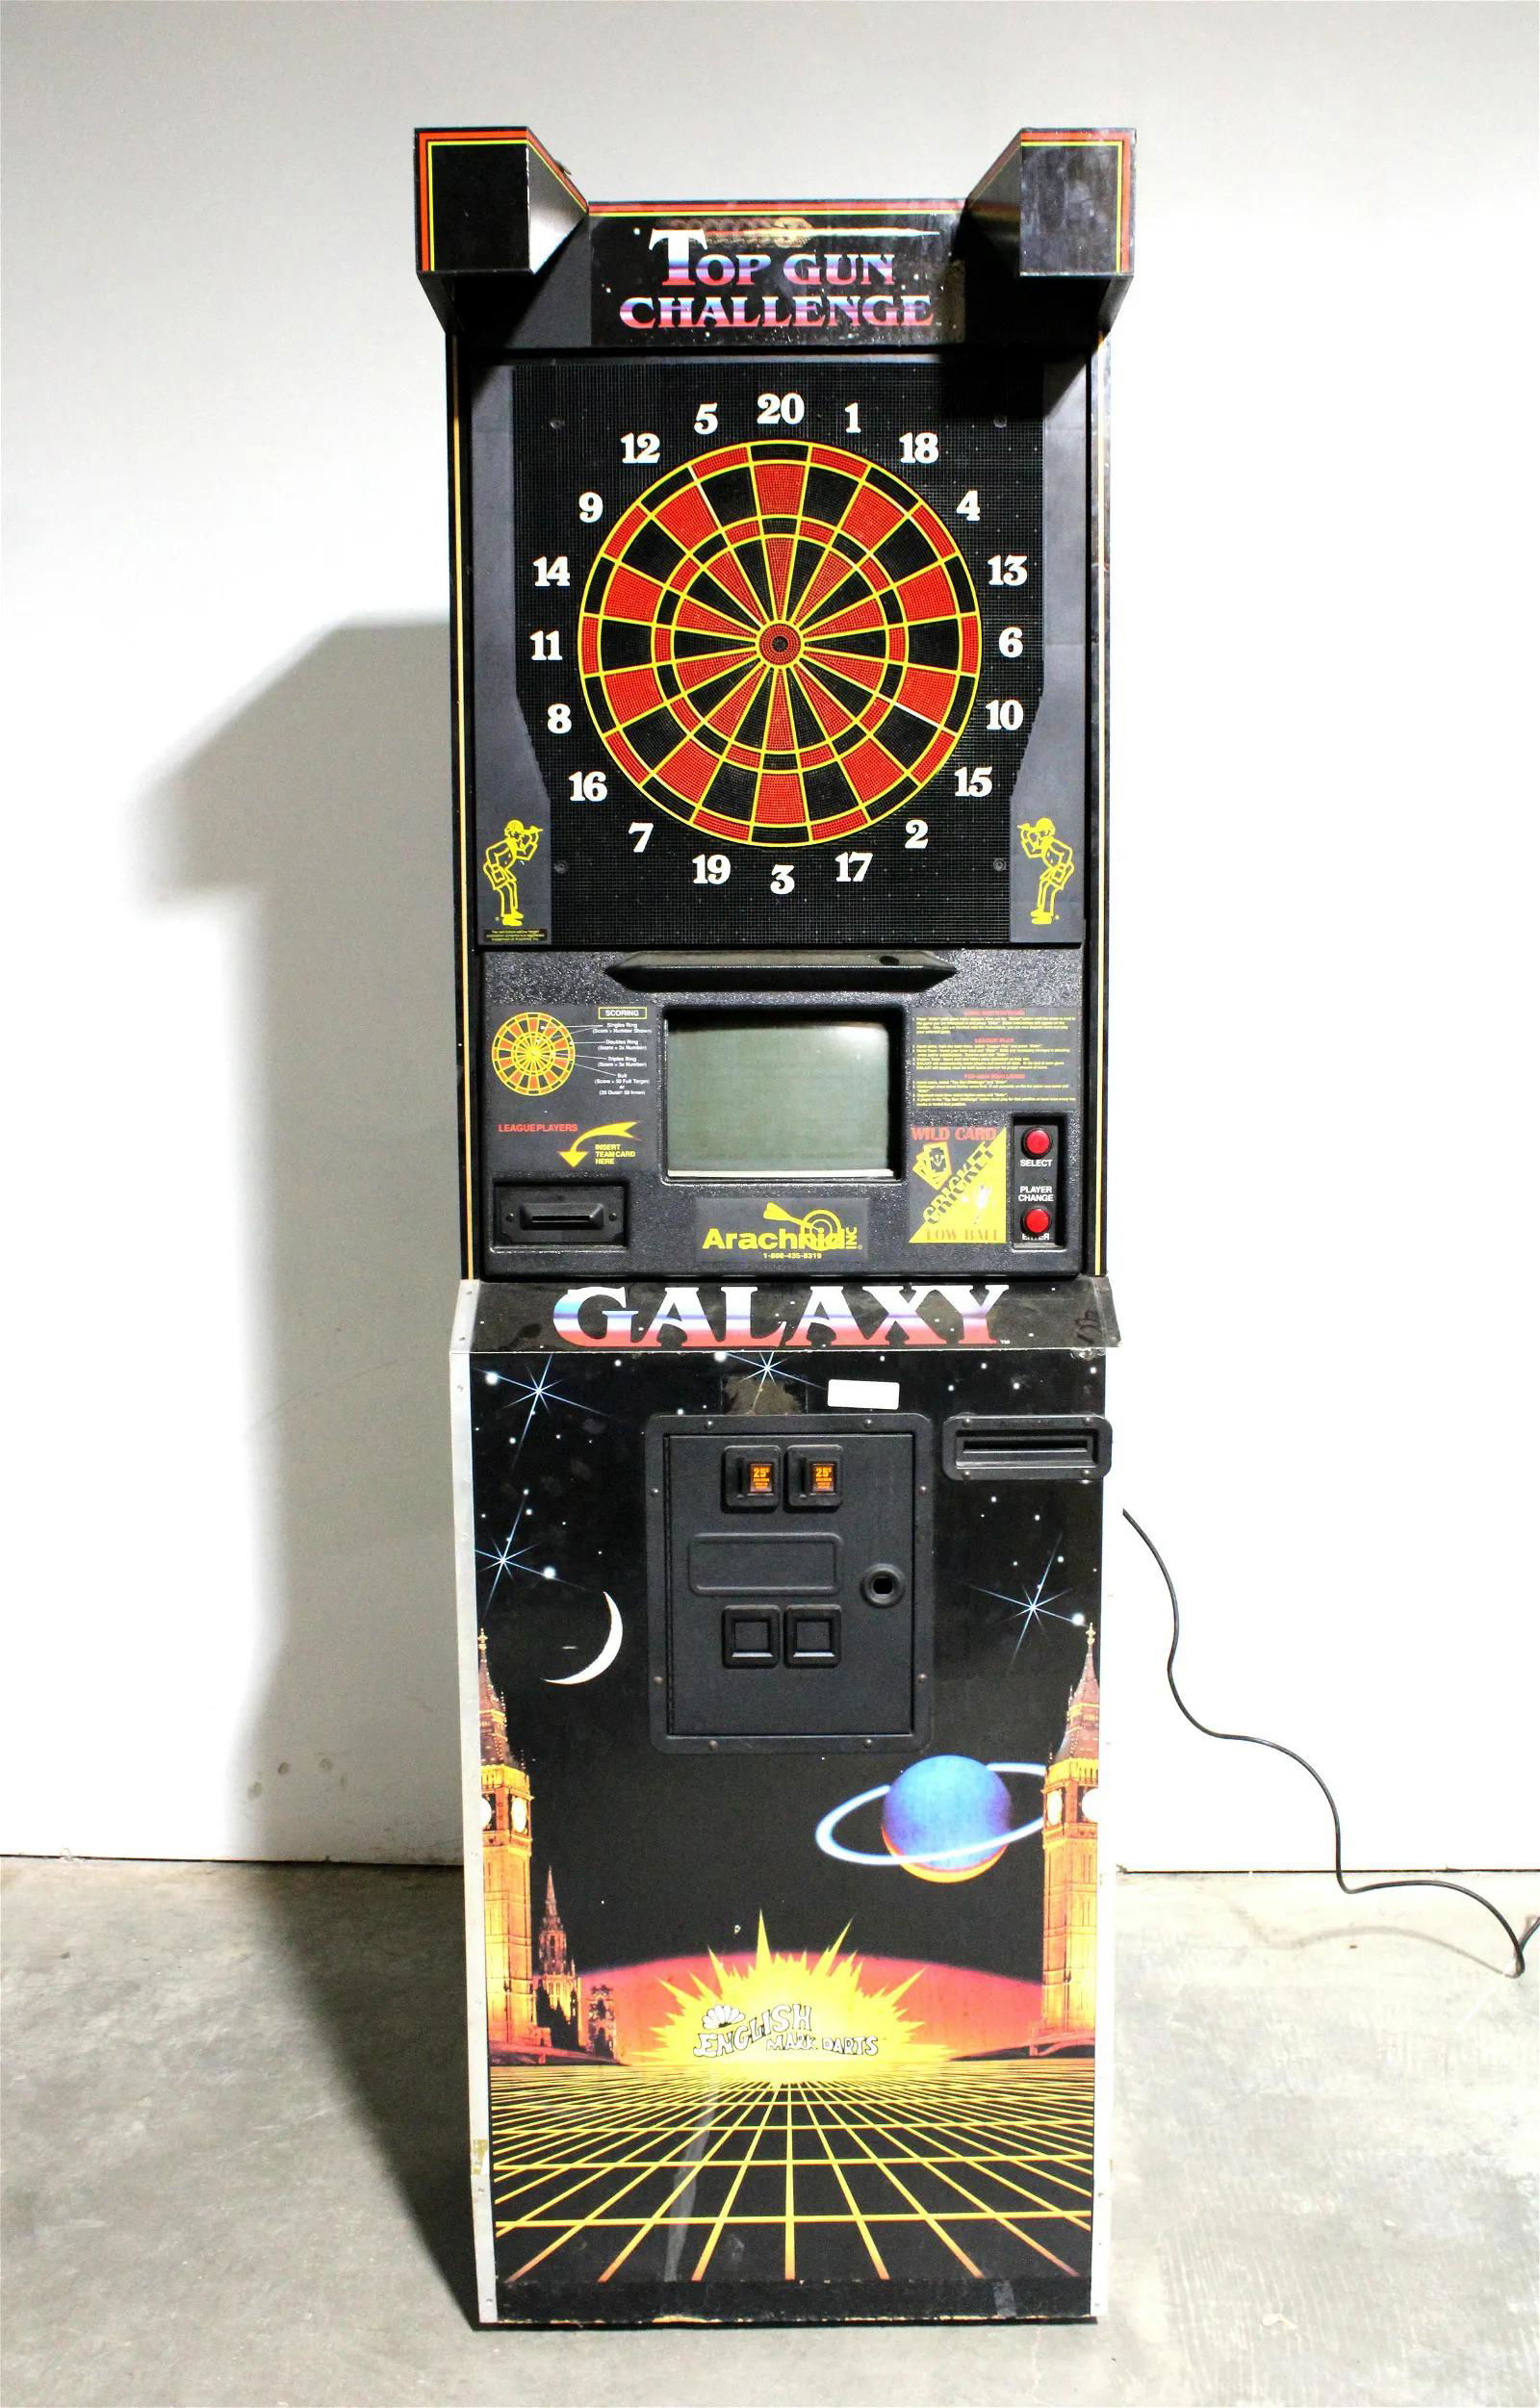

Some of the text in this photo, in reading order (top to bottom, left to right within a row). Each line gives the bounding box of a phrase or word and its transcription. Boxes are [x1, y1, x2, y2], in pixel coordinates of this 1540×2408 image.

[783, 253, 895, 286] GUN
[619, 295, 934, 329] CHALLENGE
[694, 403, 718, 434] 5
[757, 394, 805, 424] 20
[845, 403, 860, 432] 1
[621, 433, 659, 463] 12
[899, 433, 938, 463] 18
[579, 493, 603, 523] 9
[957, 491, 980, 521] 4
[533, 556, 570, 586] 14
[988, 555, 1027, 585] 13
[530, 631, 562, 660] 11
[999, 628, 1023, 657] 6
[548, 704, 572, 733] 8
[986, 700, 1023, 730] 10
[569, 772, 607, 801] 16
[955, 767, 992, 797] 15
[629, 823, 654, 852] 7
[905, 820, 928, 848] 2
[693, 855, 731, 884] 19
[771, 864, 794, 894] 3
[835, 852, 873, 882] 17
[499, 1123, 578, 1132] LEAGUE PLAYERS
[911, 1127, 997, 1140] WILD CARD
[1020, 1159, 1053, 1167] SELECT
[1018, 1193, 1054, 1202] CHANGE
[702, 1227, 859, 1251] Arachnid INC
[552, 1284, 1010, 1347] GALAXY
[693, 2003, 812, 2058] ENGLISH
[766, 2032, 879, 2056] MARK DARTS
